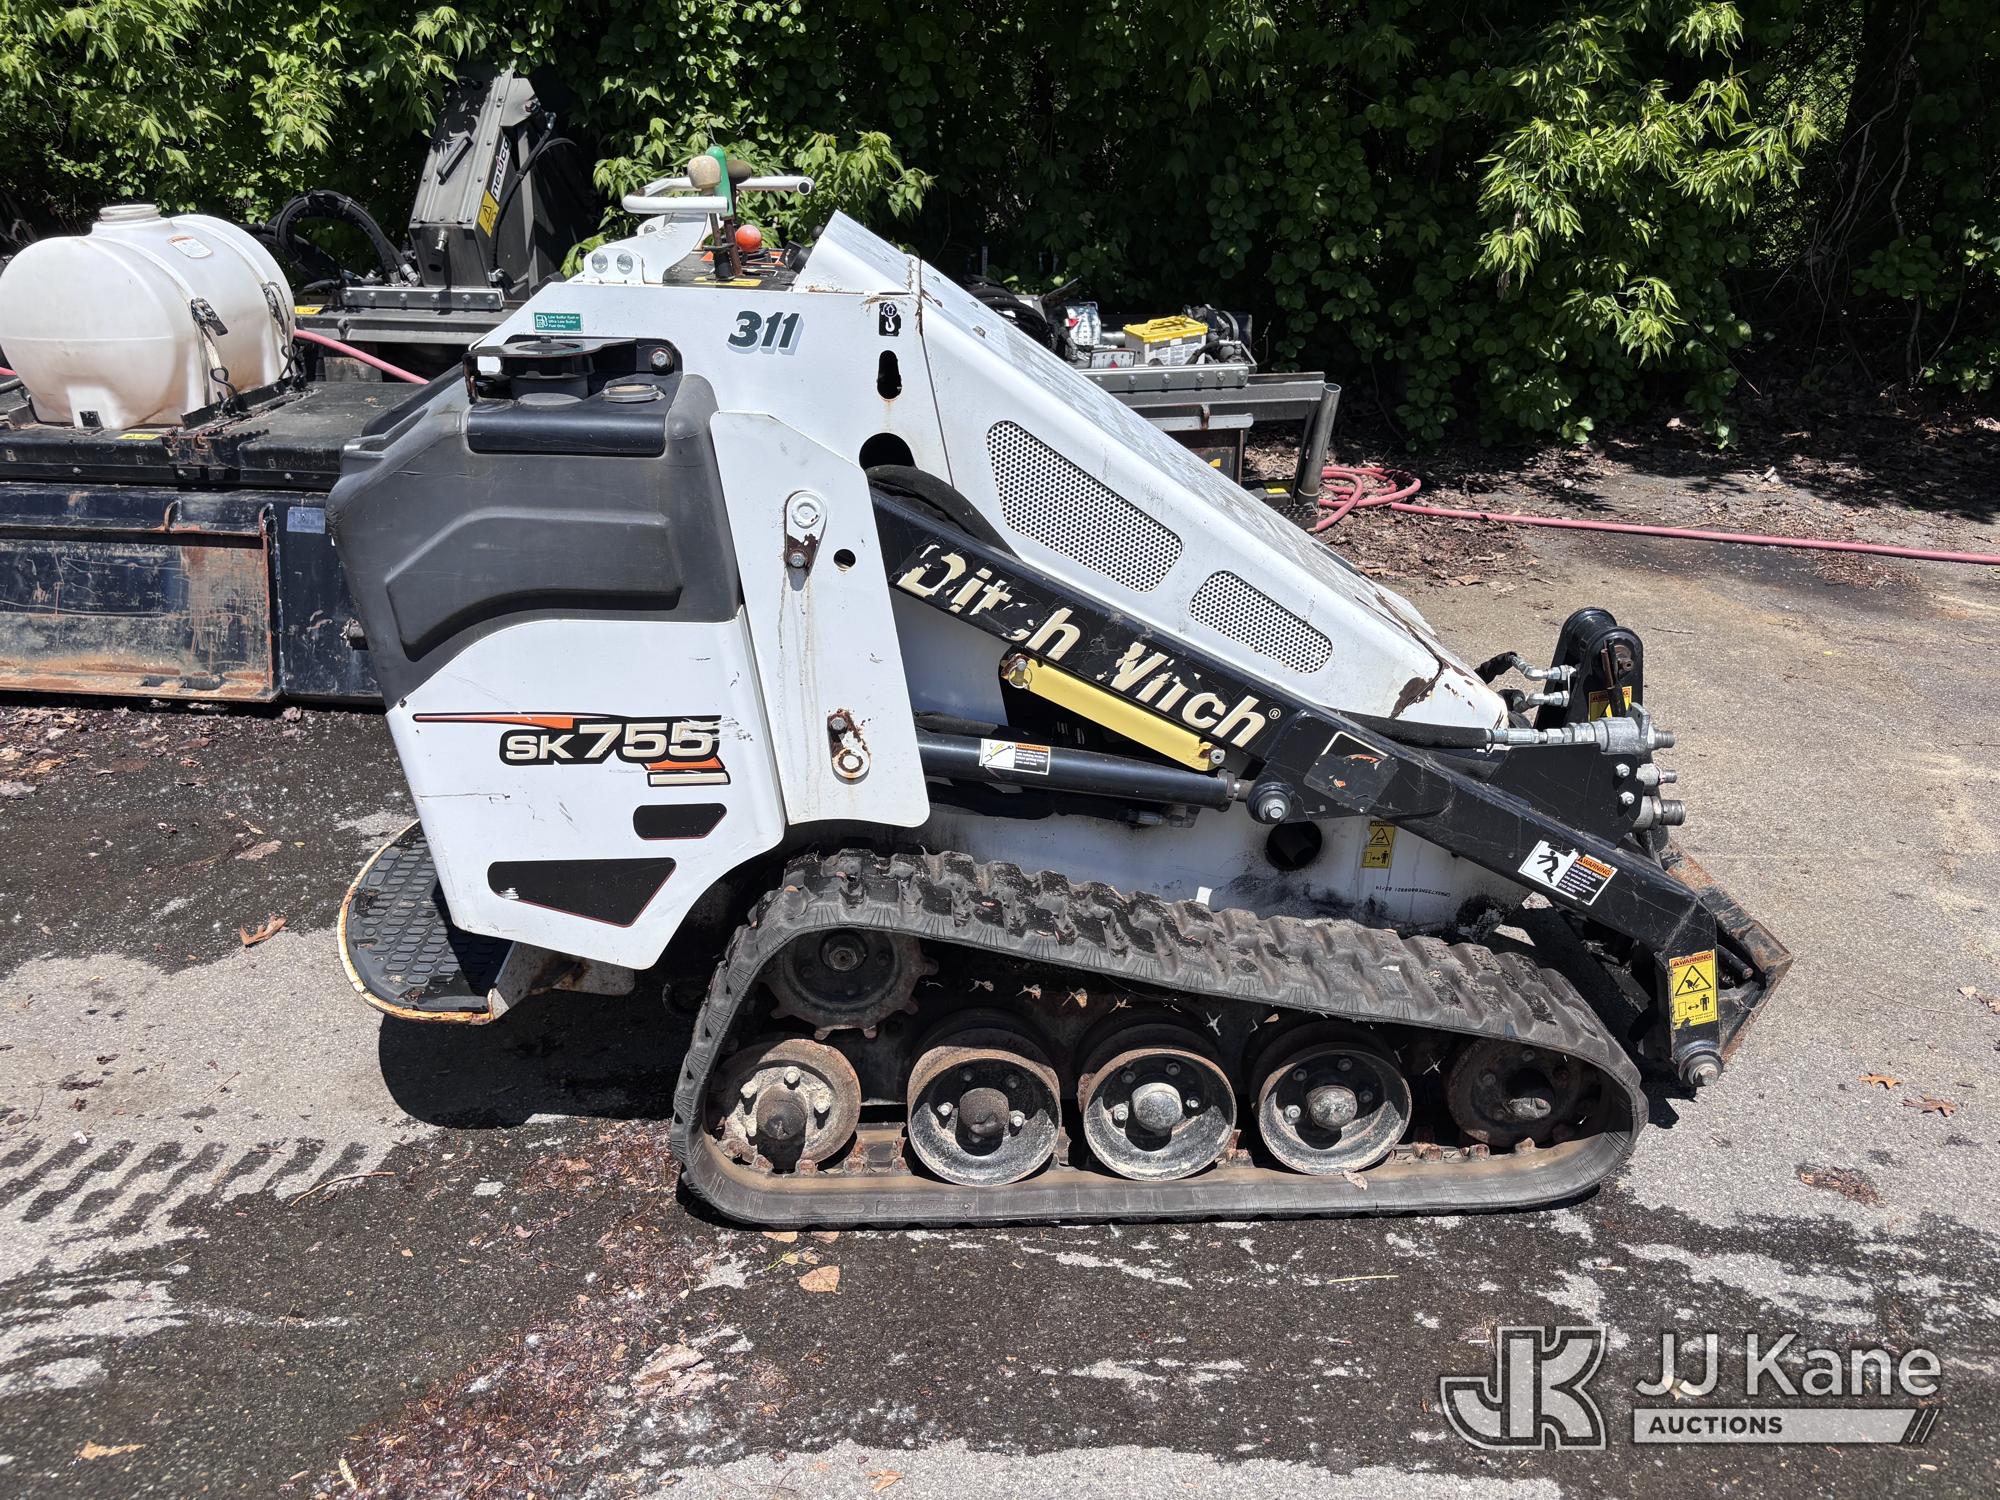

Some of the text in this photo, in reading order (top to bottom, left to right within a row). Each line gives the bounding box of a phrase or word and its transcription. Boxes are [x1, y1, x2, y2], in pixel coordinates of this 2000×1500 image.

[727, 311, 803, 353] 311
[1583, 858, 1611, 876] WARNING
[1680, 953, 1712, 966] WARNING
